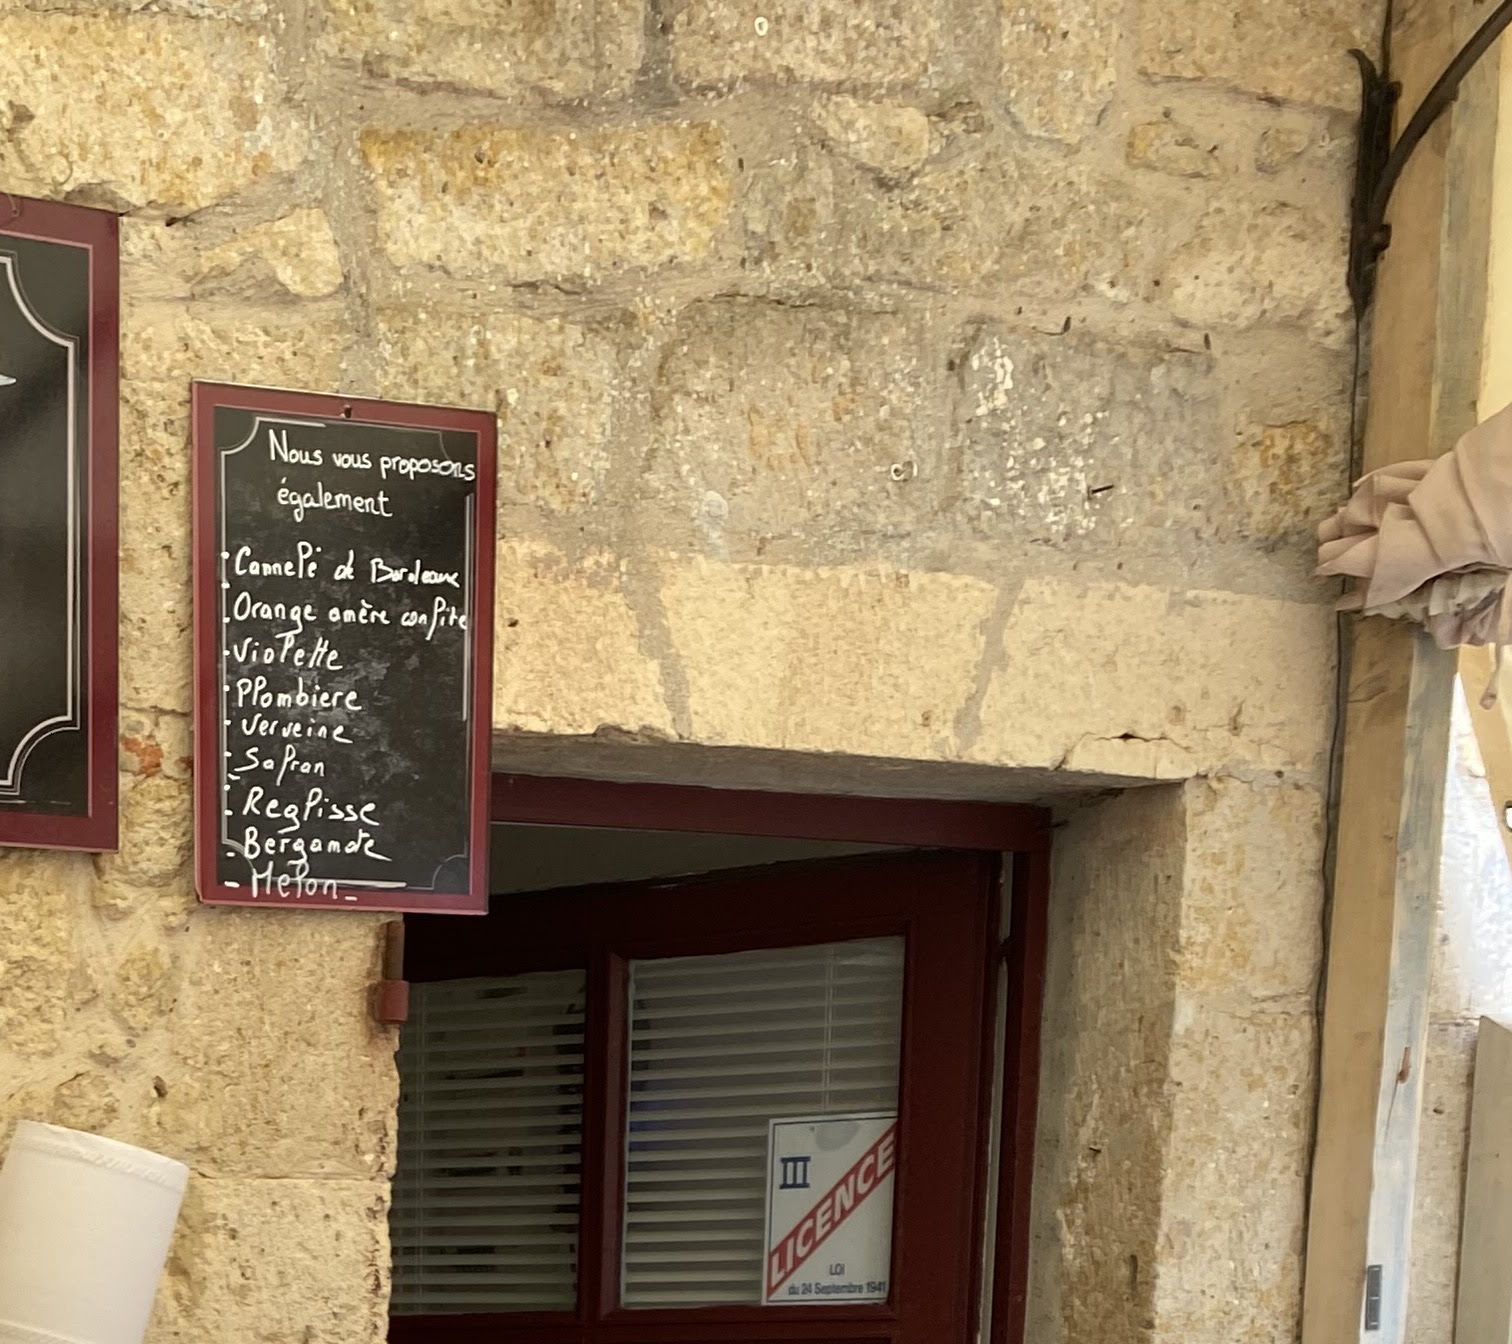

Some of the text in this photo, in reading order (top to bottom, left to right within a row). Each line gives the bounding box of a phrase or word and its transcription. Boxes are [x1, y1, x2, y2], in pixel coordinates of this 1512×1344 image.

[268, 429, 476, 481] Nous vous proposons
[277, 477, 393, 522] également
[234, 591, 317, 639] Orange
[329, 599, 391, 625] amère
[234, 633, 343, 671] Violette
[241, 713, 354, 744] Verveine
[770, 1132, 895, 1289] LICENCE
